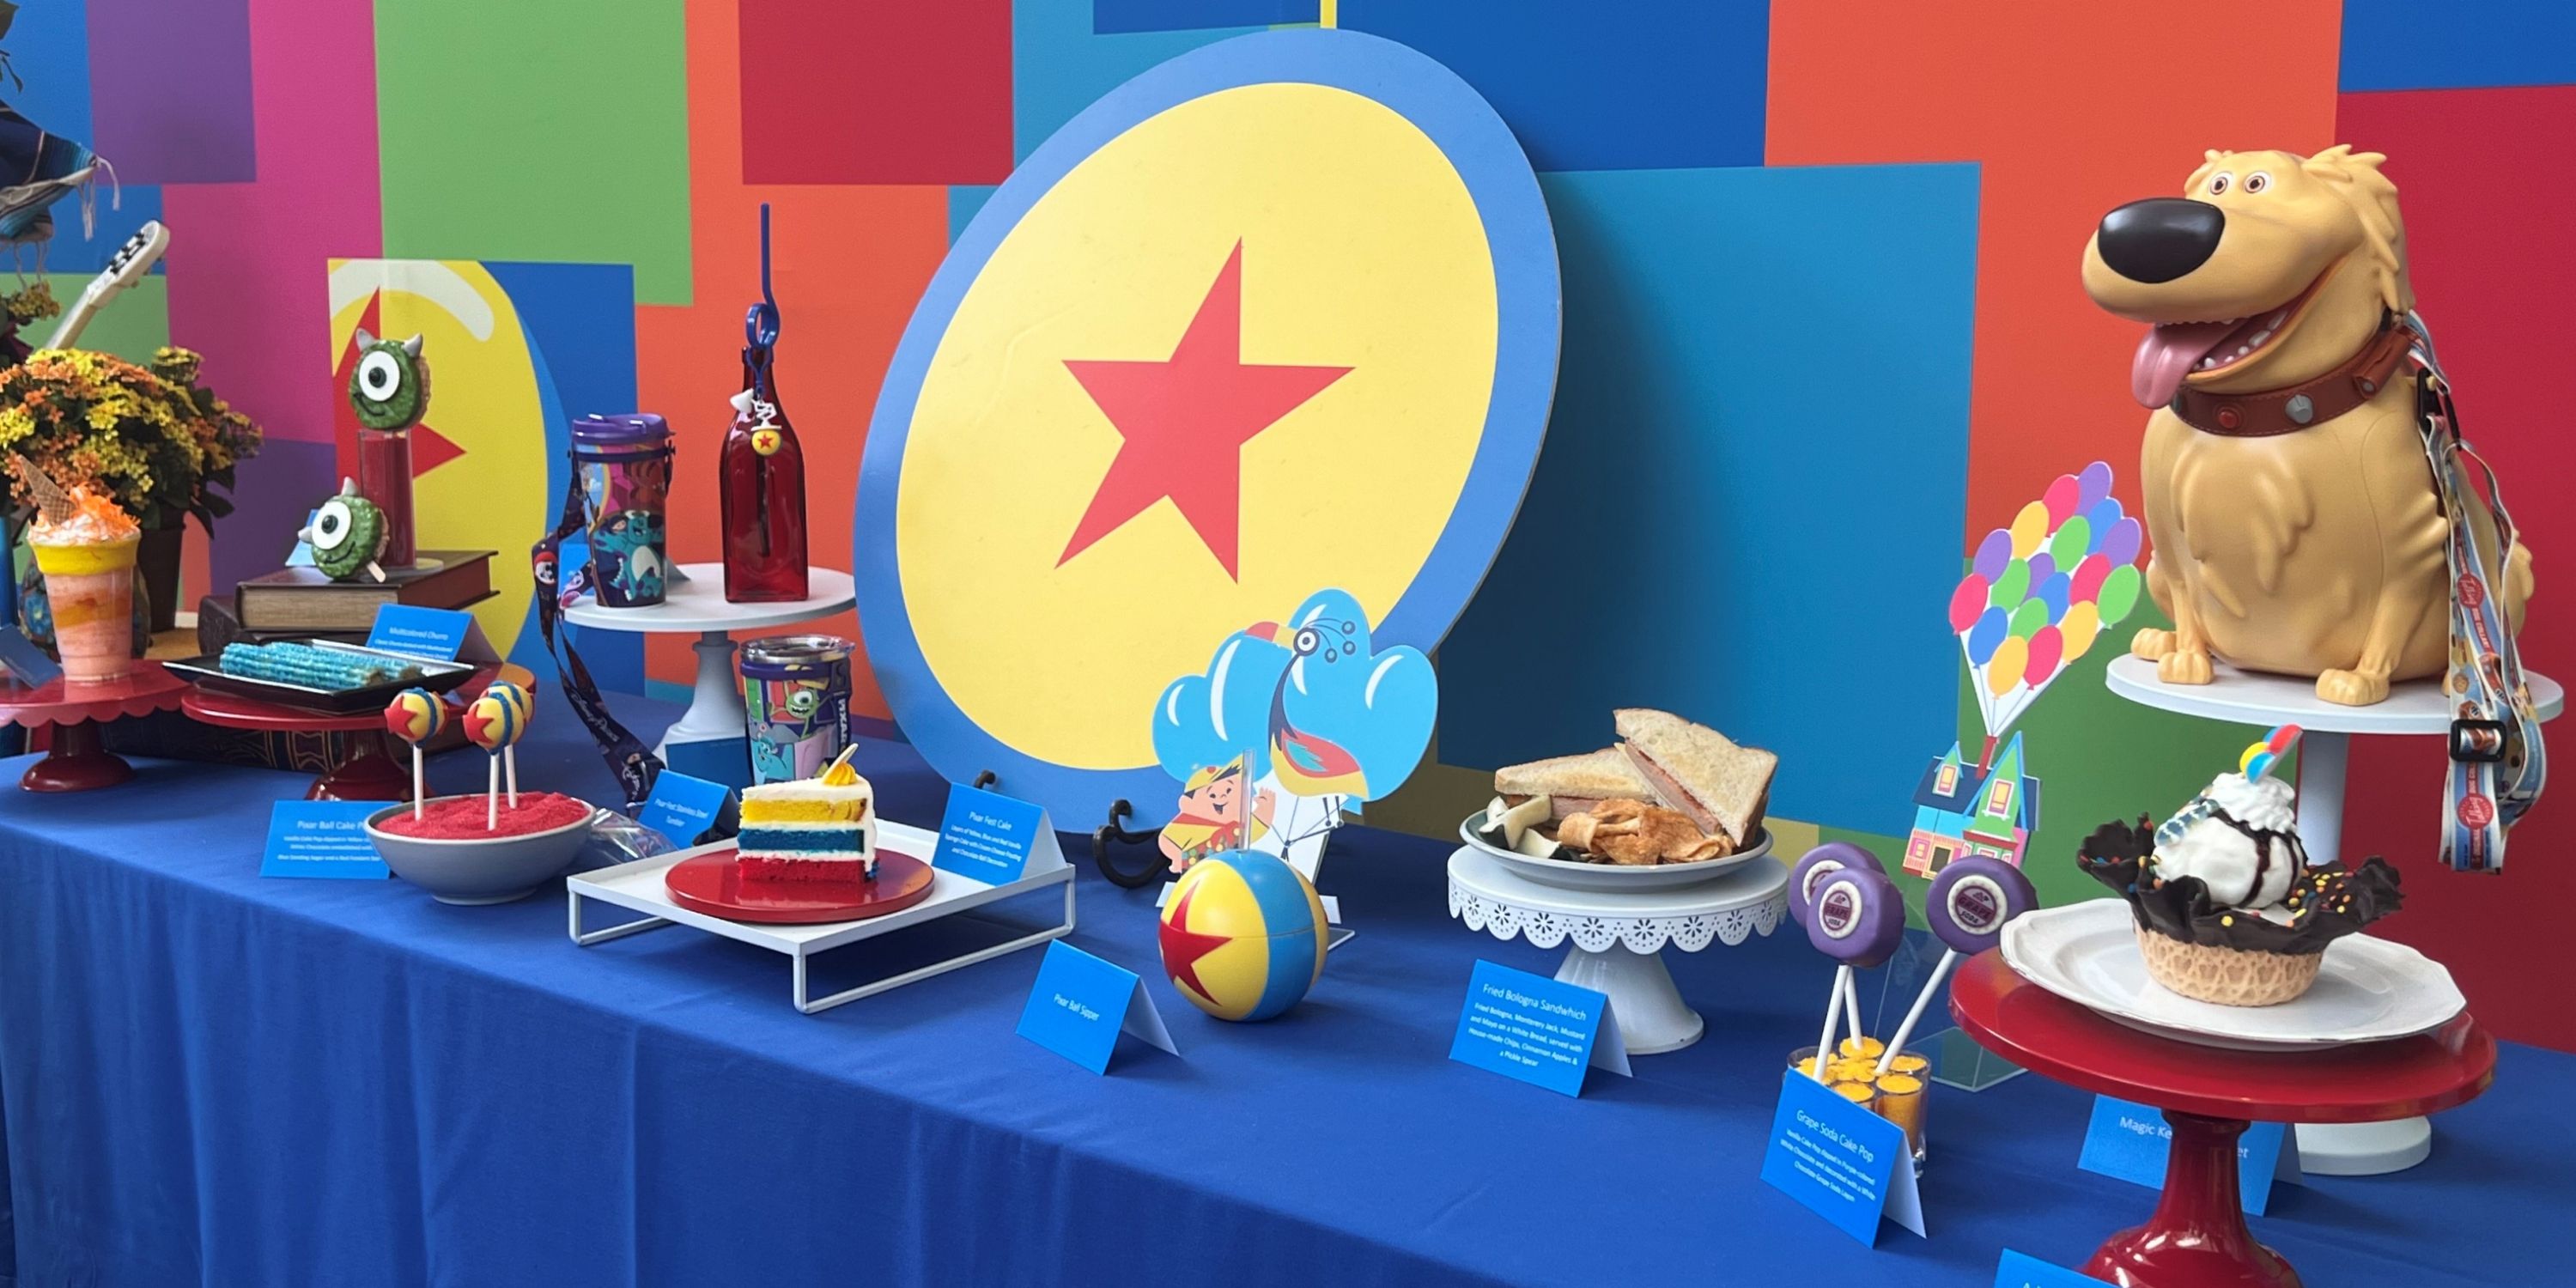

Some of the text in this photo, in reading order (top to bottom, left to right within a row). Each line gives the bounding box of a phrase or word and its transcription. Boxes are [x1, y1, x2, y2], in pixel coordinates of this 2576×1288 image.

[297, 821, 317, 829] Pixar
[319, 821, 335, 829] Ball
[969, 811, 1012, 830] Pixar Fest Cake
[1957, 896, 1992, 921] GRAPE
[1961, 911, 1978, 923] SODA
[1053, 993, 1100, 1021] Pixar Ball Sipper
[1483, 983, 1586, 1020] Fried Bologna Sandwhich
[1474, 1003, 1490, 1012] Fried
[1490, 1007, 1512, 1019] Bologna,
[1546, 1024, 1558, 1033] Jack,
[1560, 1027, 1585, 1040] Mustard
[1482, 1018, 1498, 1028] Mayo
[1512, 1027, 1529, 1037] White
[1529, 1031, 1547, 1043] Bread,
[1549, 1039, 1569, 1048] served
[1468, 1028, 1504, 1042] House-made
[1504, 1037, 1520, 1048] Chips,
[1522, 1043, 1551, 1056] Cinnamon
[1552, 1052, 1571, 1063] Apples
[1504, 1051, 1522, 1061] Pickle
[1522, 1056, 1539, 1066] Spear
[1797, 1110, 1874, 1163] Grape Soda Cake Pop
[2119, 1116, 2155, 1135] Magic
